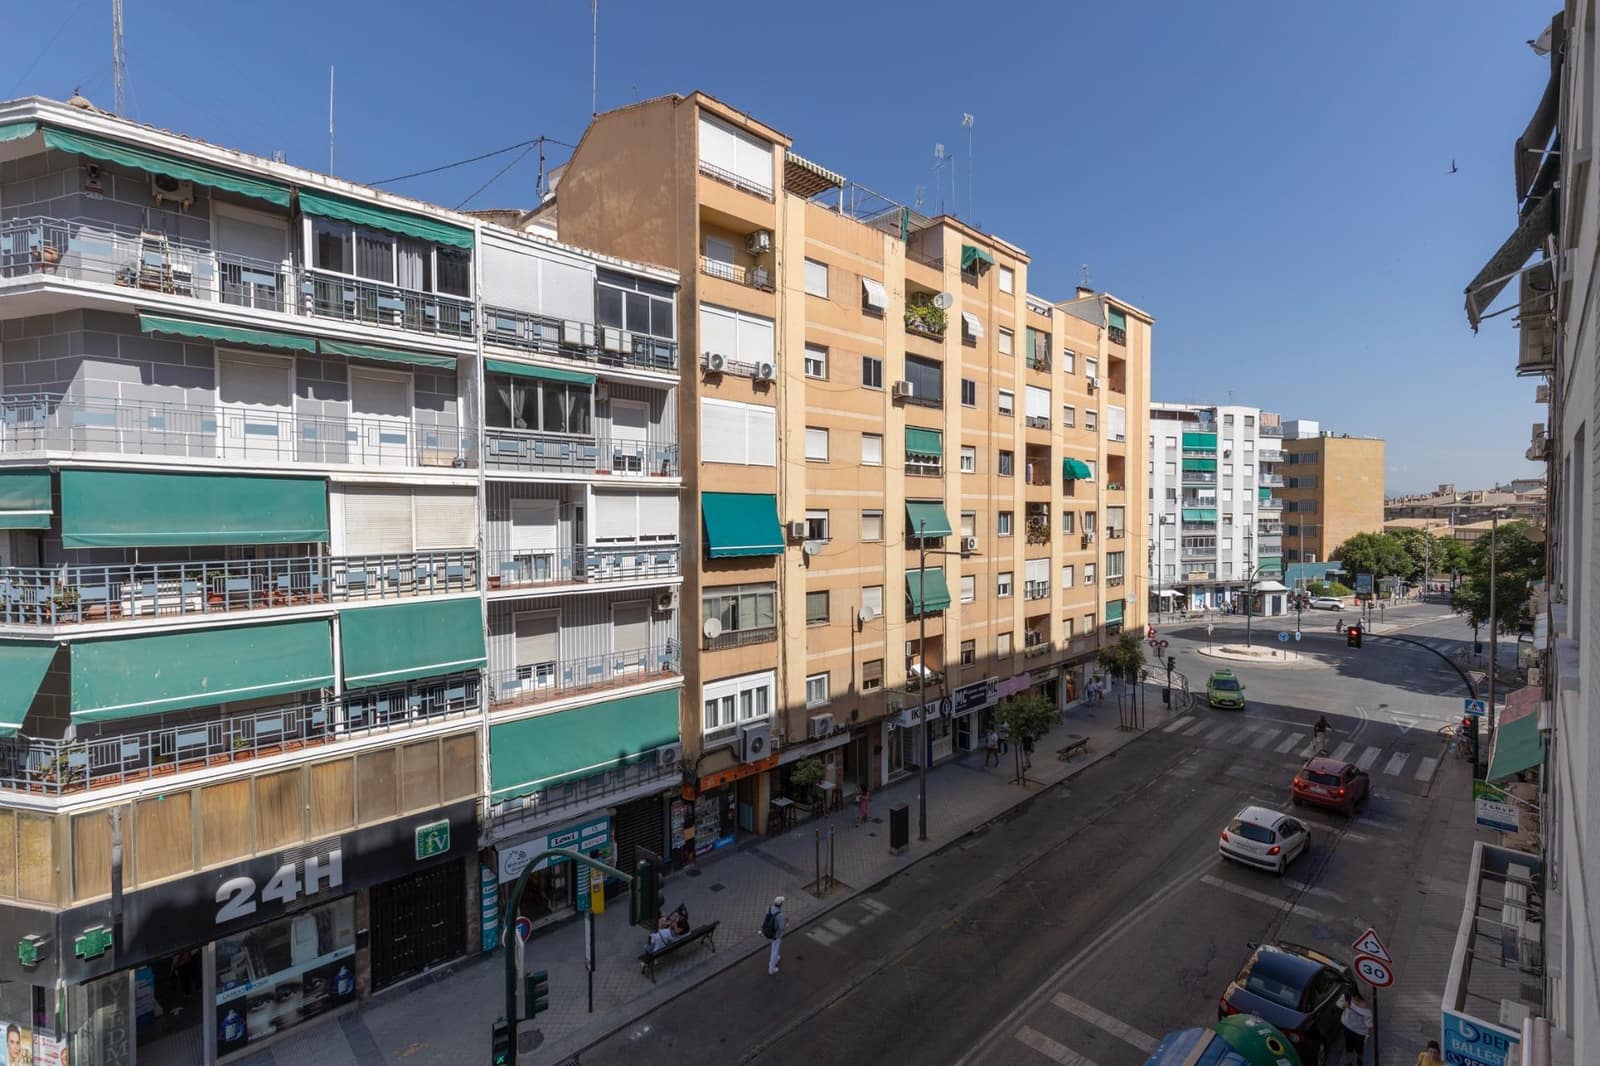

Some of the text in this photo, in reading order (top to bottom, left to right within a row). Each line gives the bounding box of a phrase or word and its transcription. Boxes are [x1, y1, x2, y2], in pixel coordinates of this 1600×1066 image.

[911, 703, 937, 721] IKNJI
[554, 833, 576, 846] Lowi
[215, 849, 343, 924] 24H
[1362, 964, 1385, 980] 30
